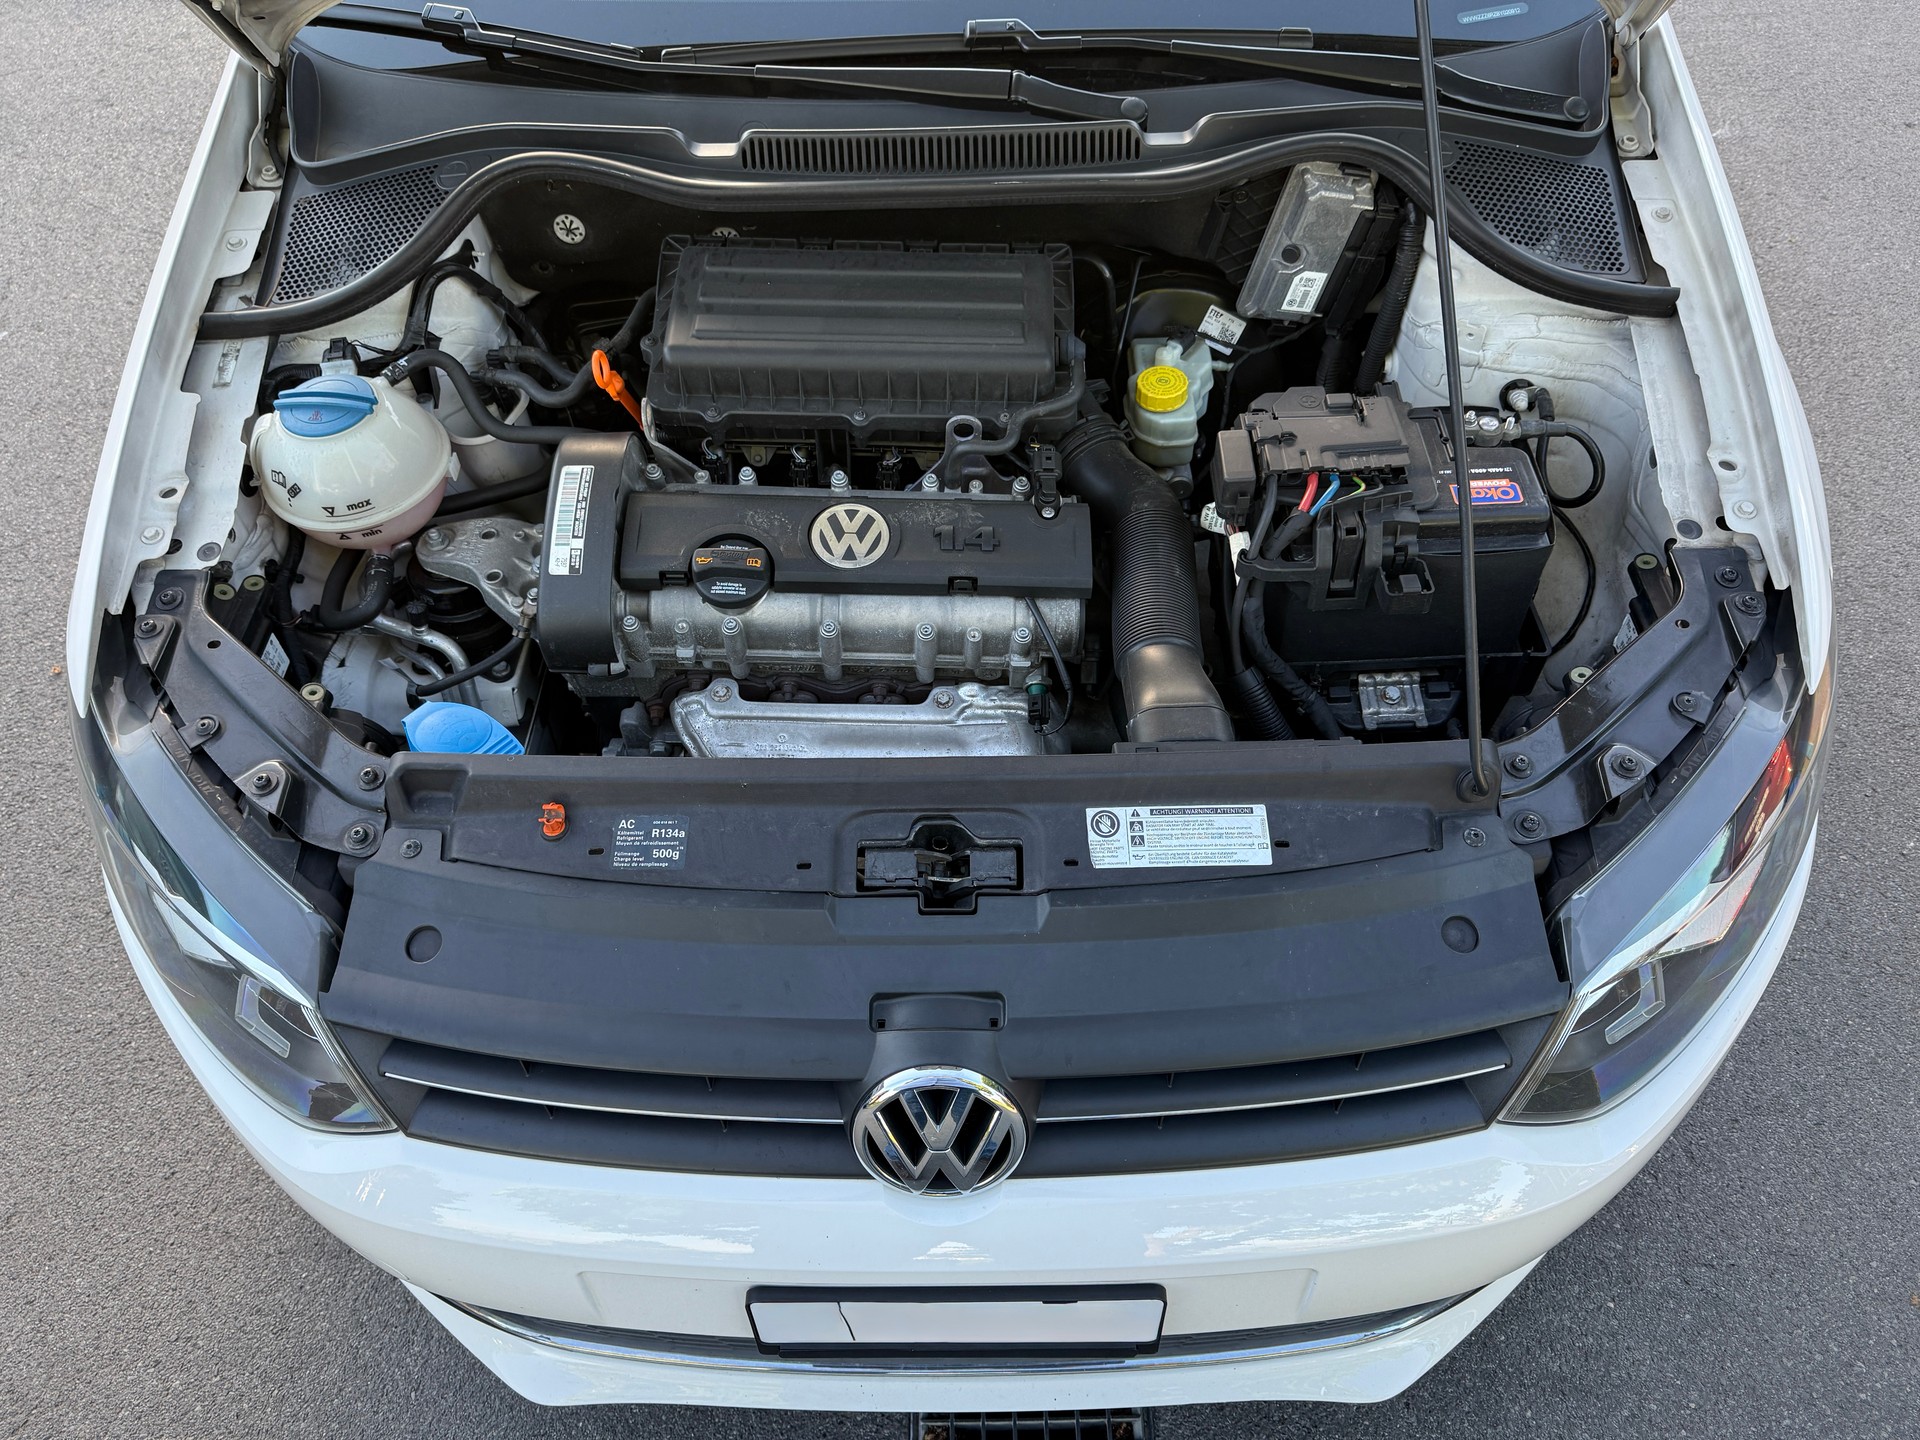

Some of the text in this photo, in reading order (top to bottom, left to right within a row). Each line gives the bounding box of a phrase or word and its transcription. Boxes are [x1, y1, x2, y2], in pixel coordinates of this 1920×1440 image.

[346, 498, 372, 512] max
[362, 528, 383, 539] min
[933, 525, 1000, 551] 1.4
[618, 819, 635, 829] AC
[652, 828, 685, 838] R134a
[652, 849, 680, 860] 500g
